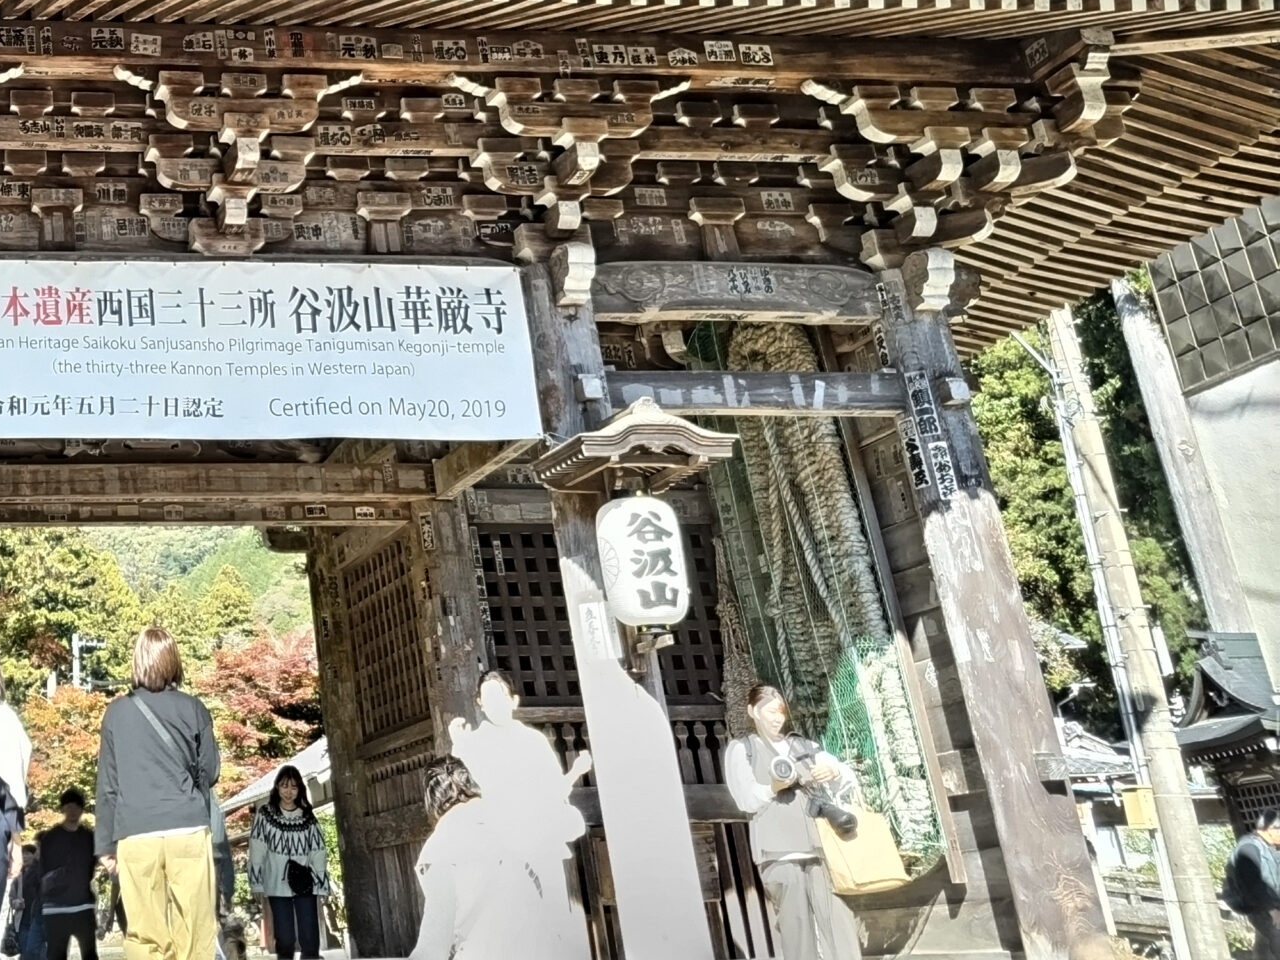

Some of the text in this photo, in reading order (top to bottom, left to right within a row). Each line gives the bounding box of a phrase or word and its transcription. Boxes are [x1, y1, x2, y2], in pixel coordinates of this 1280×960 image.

[288, 285, 508, 335] 谷汲山華厳寺
[19, 337, 79, 352] Heritage
[83, 337, 136, 350] Saikoku
[141, 337, 225, 353] Sanjusansho
[229, 339, 303, 356] Pilgrimage
[307, 338, 395, 354] Tanigumisan
[398, 339, 506, 357] Kegonji-temple
[52, 358, 416, 379] (the thirty-three Kannon Temples in Western Japan)
[268, 396, 507, 422] Certified on May20, 2019
[627, 511, 680, 610] 谷汲山
